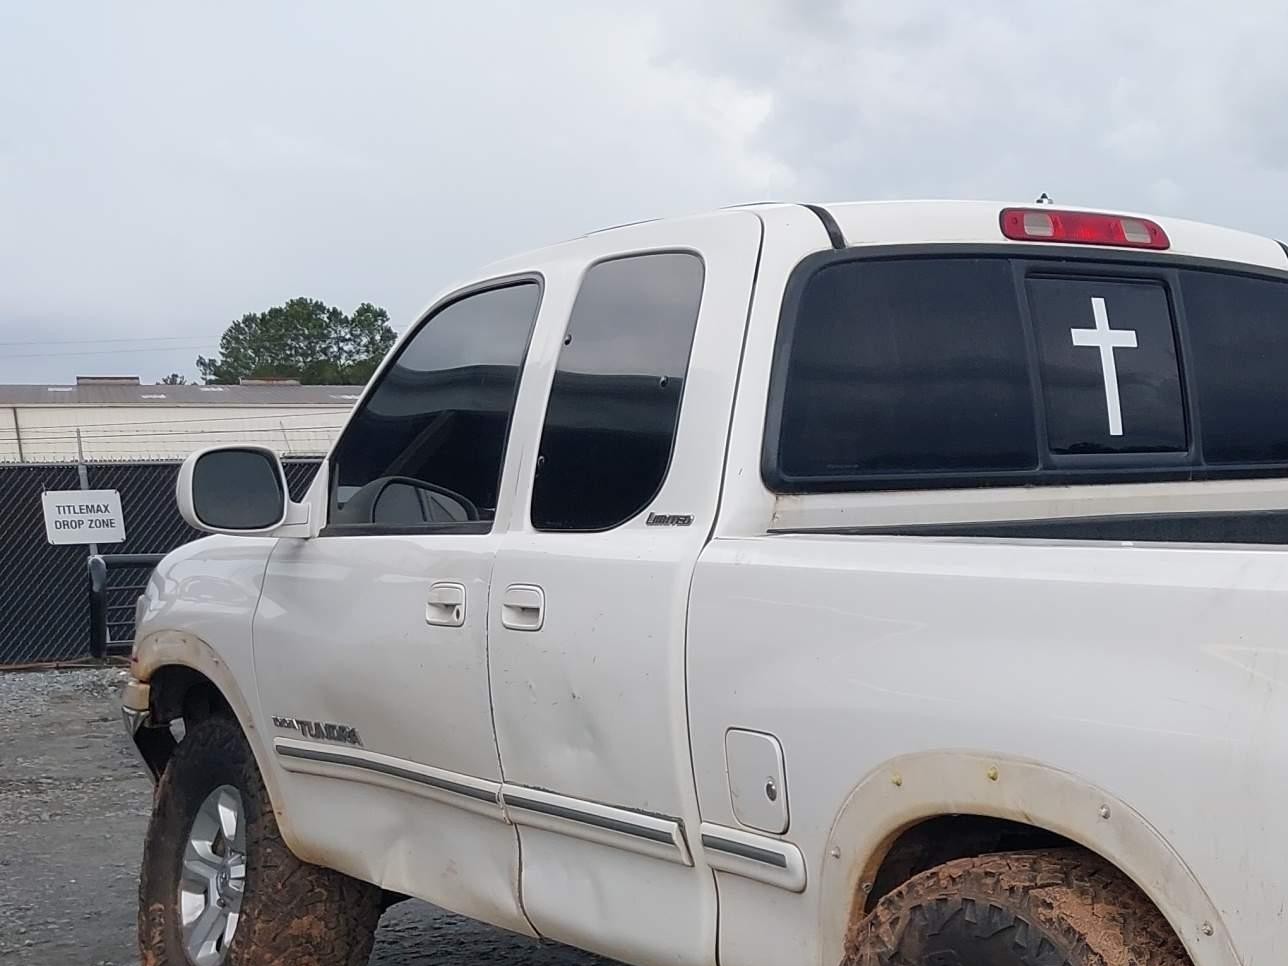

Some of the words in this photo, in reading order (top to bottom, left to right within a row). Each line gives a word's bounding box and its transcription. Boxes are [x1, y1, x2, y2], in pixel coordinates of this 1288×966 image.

[56, 504, 111, 515] TITLEMAX
[54, 519, 85, 530] DROP
[87, 518, 117, 529] ZONE
